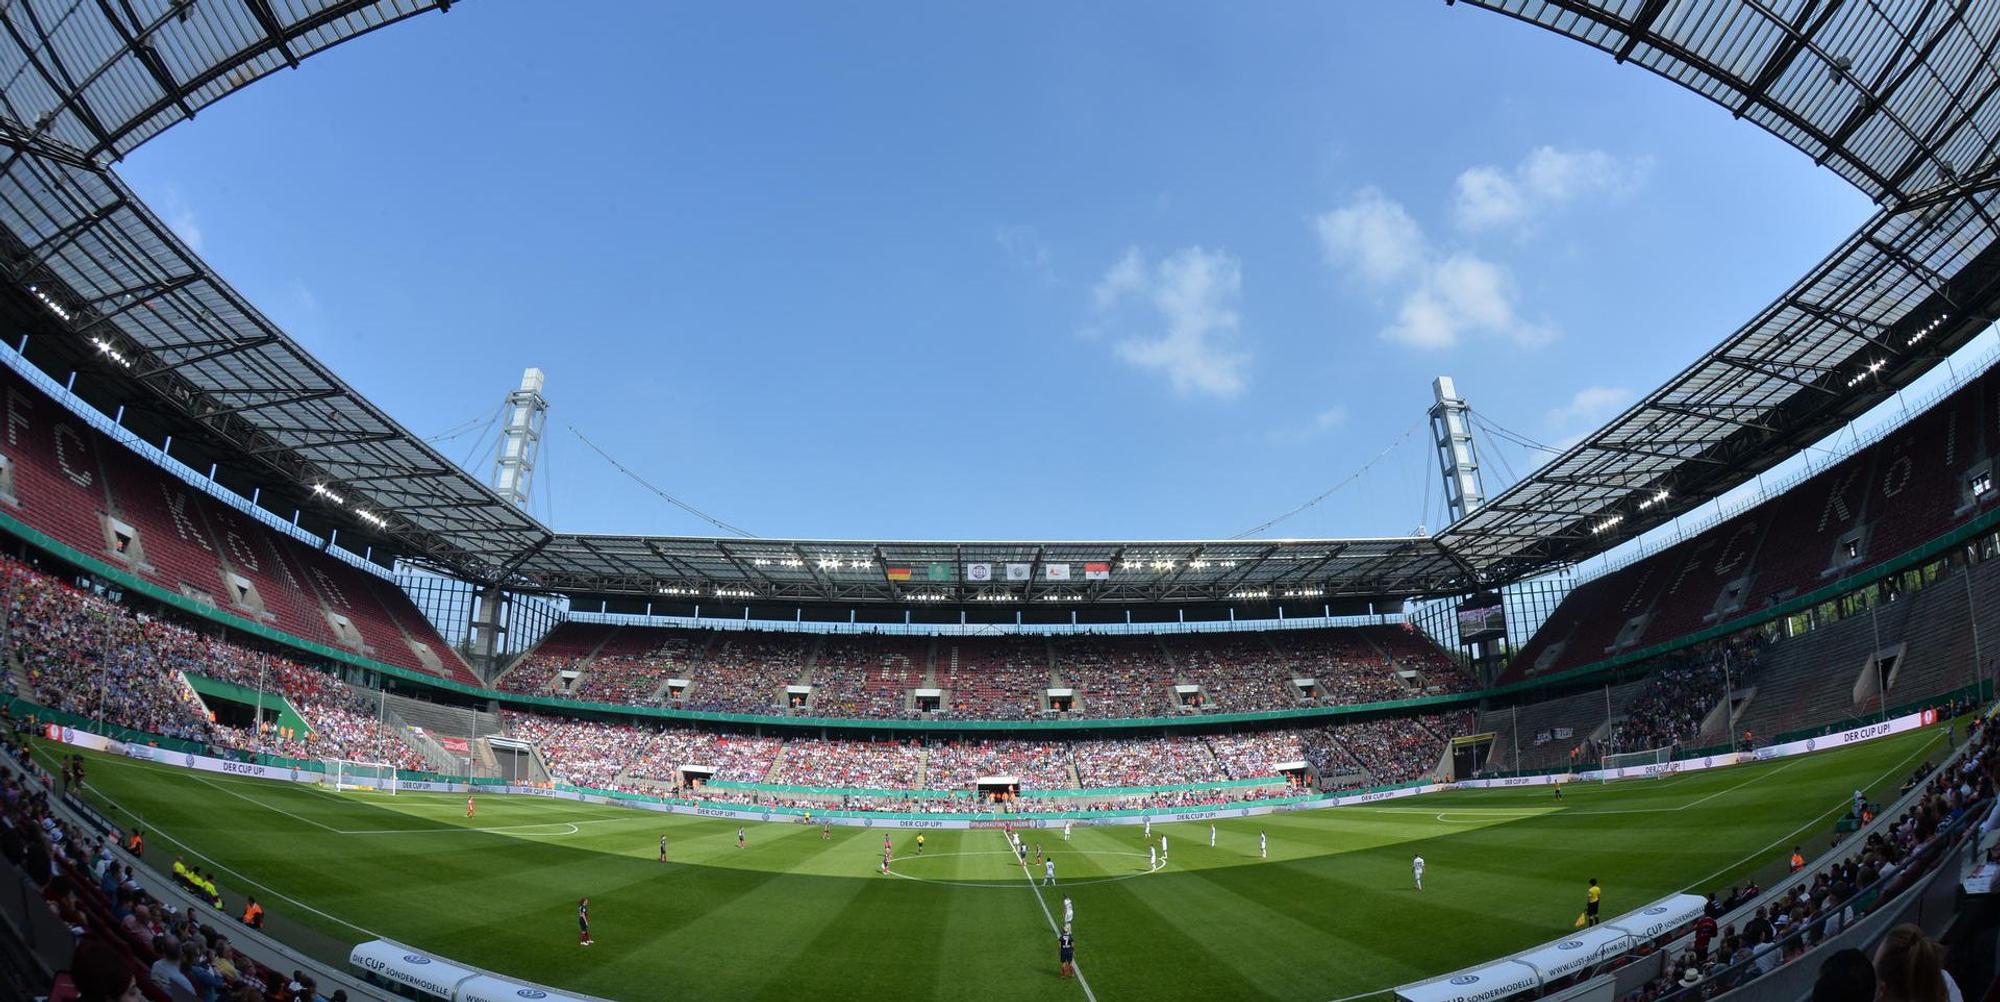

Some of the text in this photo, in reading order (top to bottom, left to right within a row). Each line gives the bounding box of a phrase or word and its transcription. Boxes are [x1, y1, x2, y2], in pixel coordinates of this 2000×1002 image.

[1844, 723, 1890, 742] DER CUP UP!
[223, 762, 237, 772] DER
[238, 764, 253, 774] CUP
[710, 809, 724, 817] CUP
[899, 820, 913, 828] DER
[914, 820, 929, 828] CUP
[1646, 922, 1664, 937] CUP
[352, 954, 364, 965] DIE
[365, 957, 386, 971] CUP
